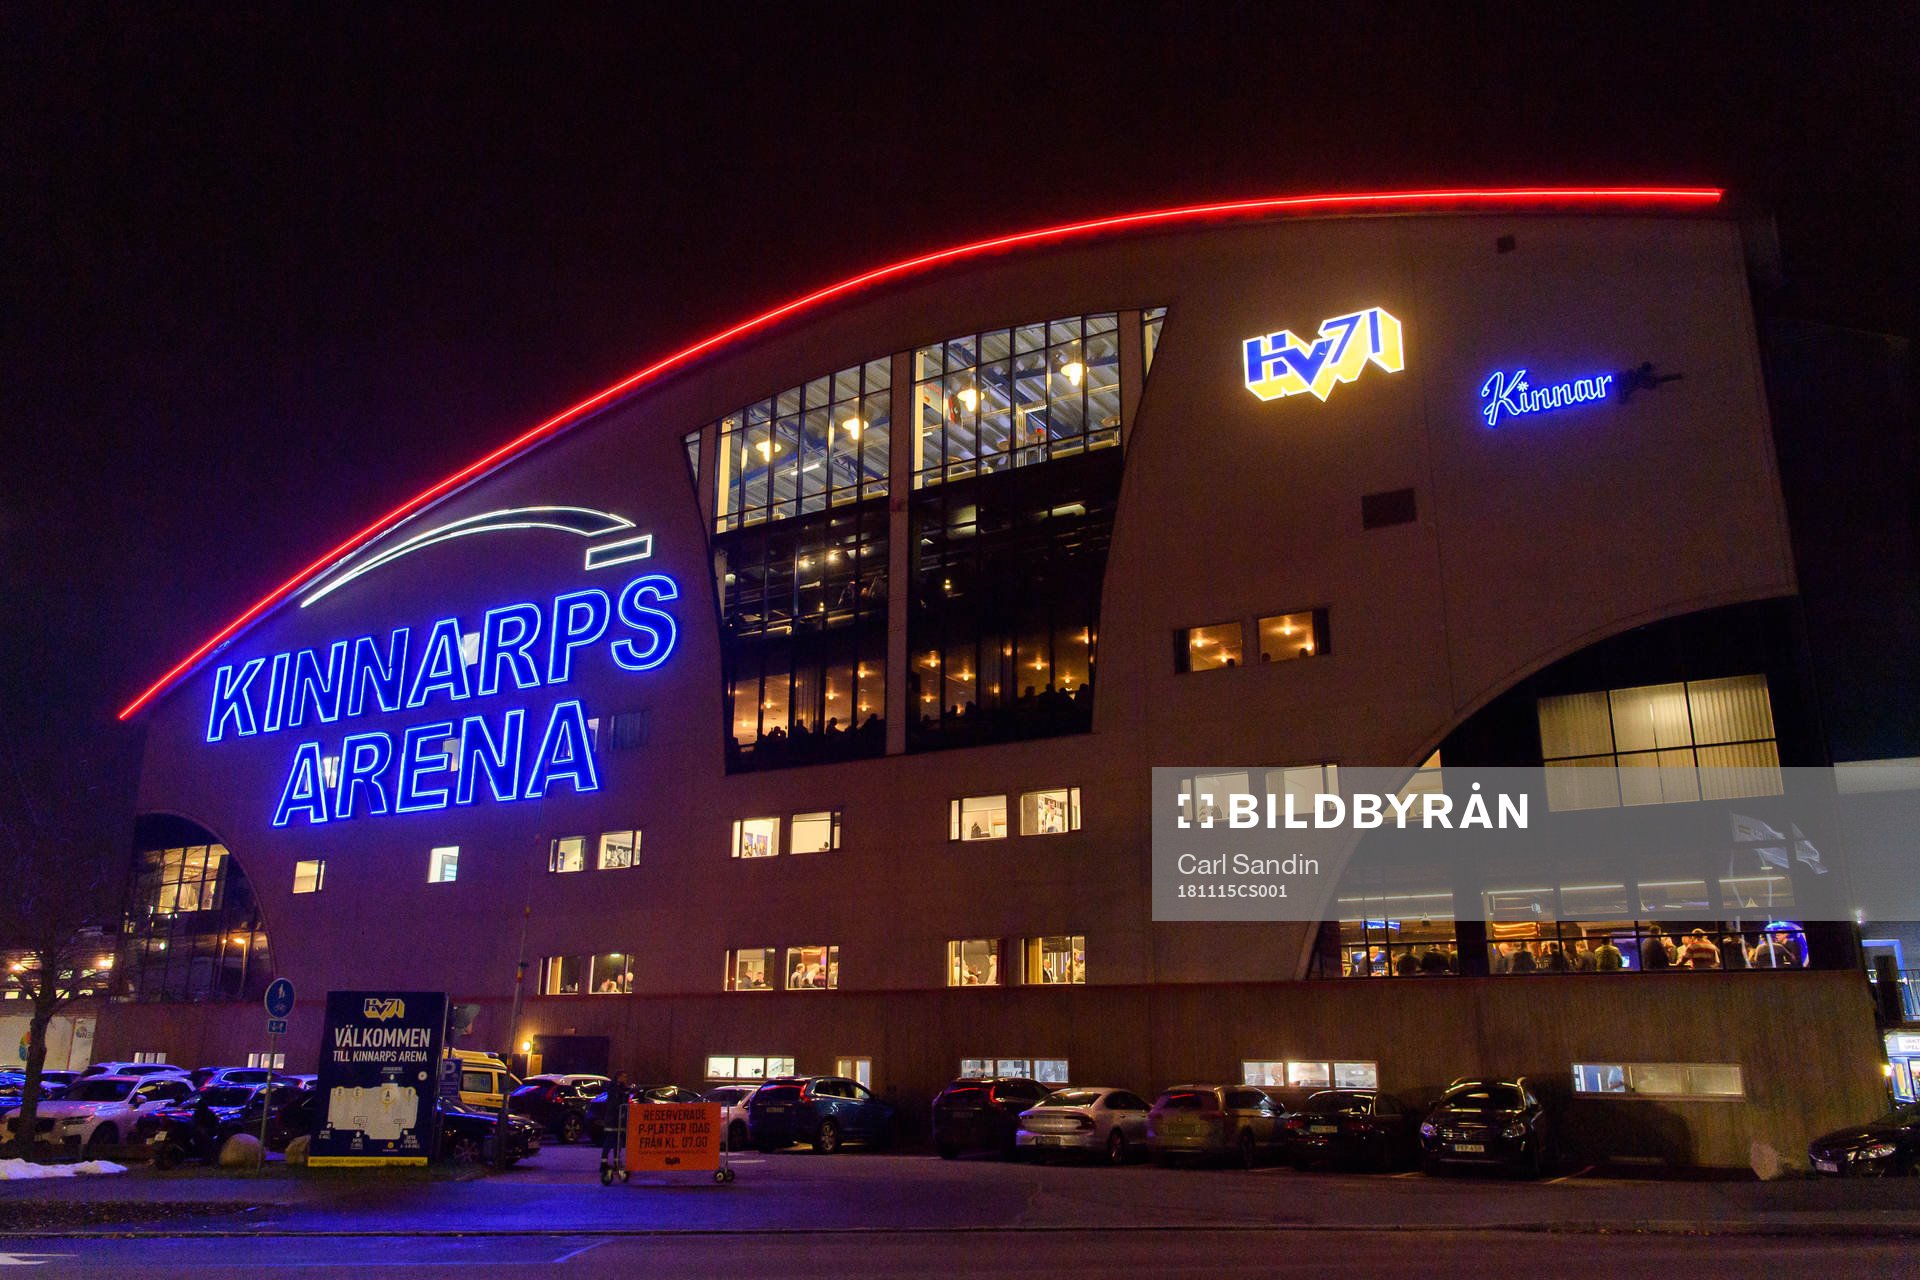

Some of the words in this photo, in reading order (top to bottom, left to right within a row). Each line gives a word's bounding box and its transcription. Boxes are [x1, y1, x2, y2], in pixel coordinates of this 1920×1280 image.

[1243, 306, 1404, 402] HV71
[206, 574, 679, 743] KINNARPS
[272, 699, 600, 827] ARENA
[363, 998, 406, 1022] HV71
[334, 1024, 432, 1048] VÄLKOMMEN
[333, 1050, 351, 1063] TILL
[352, 1050, 397, 1063] KINNARPS
[399, 1050, 428, 1063] ARENA
[643, 1109, 707, 1121] RESERVERADE
